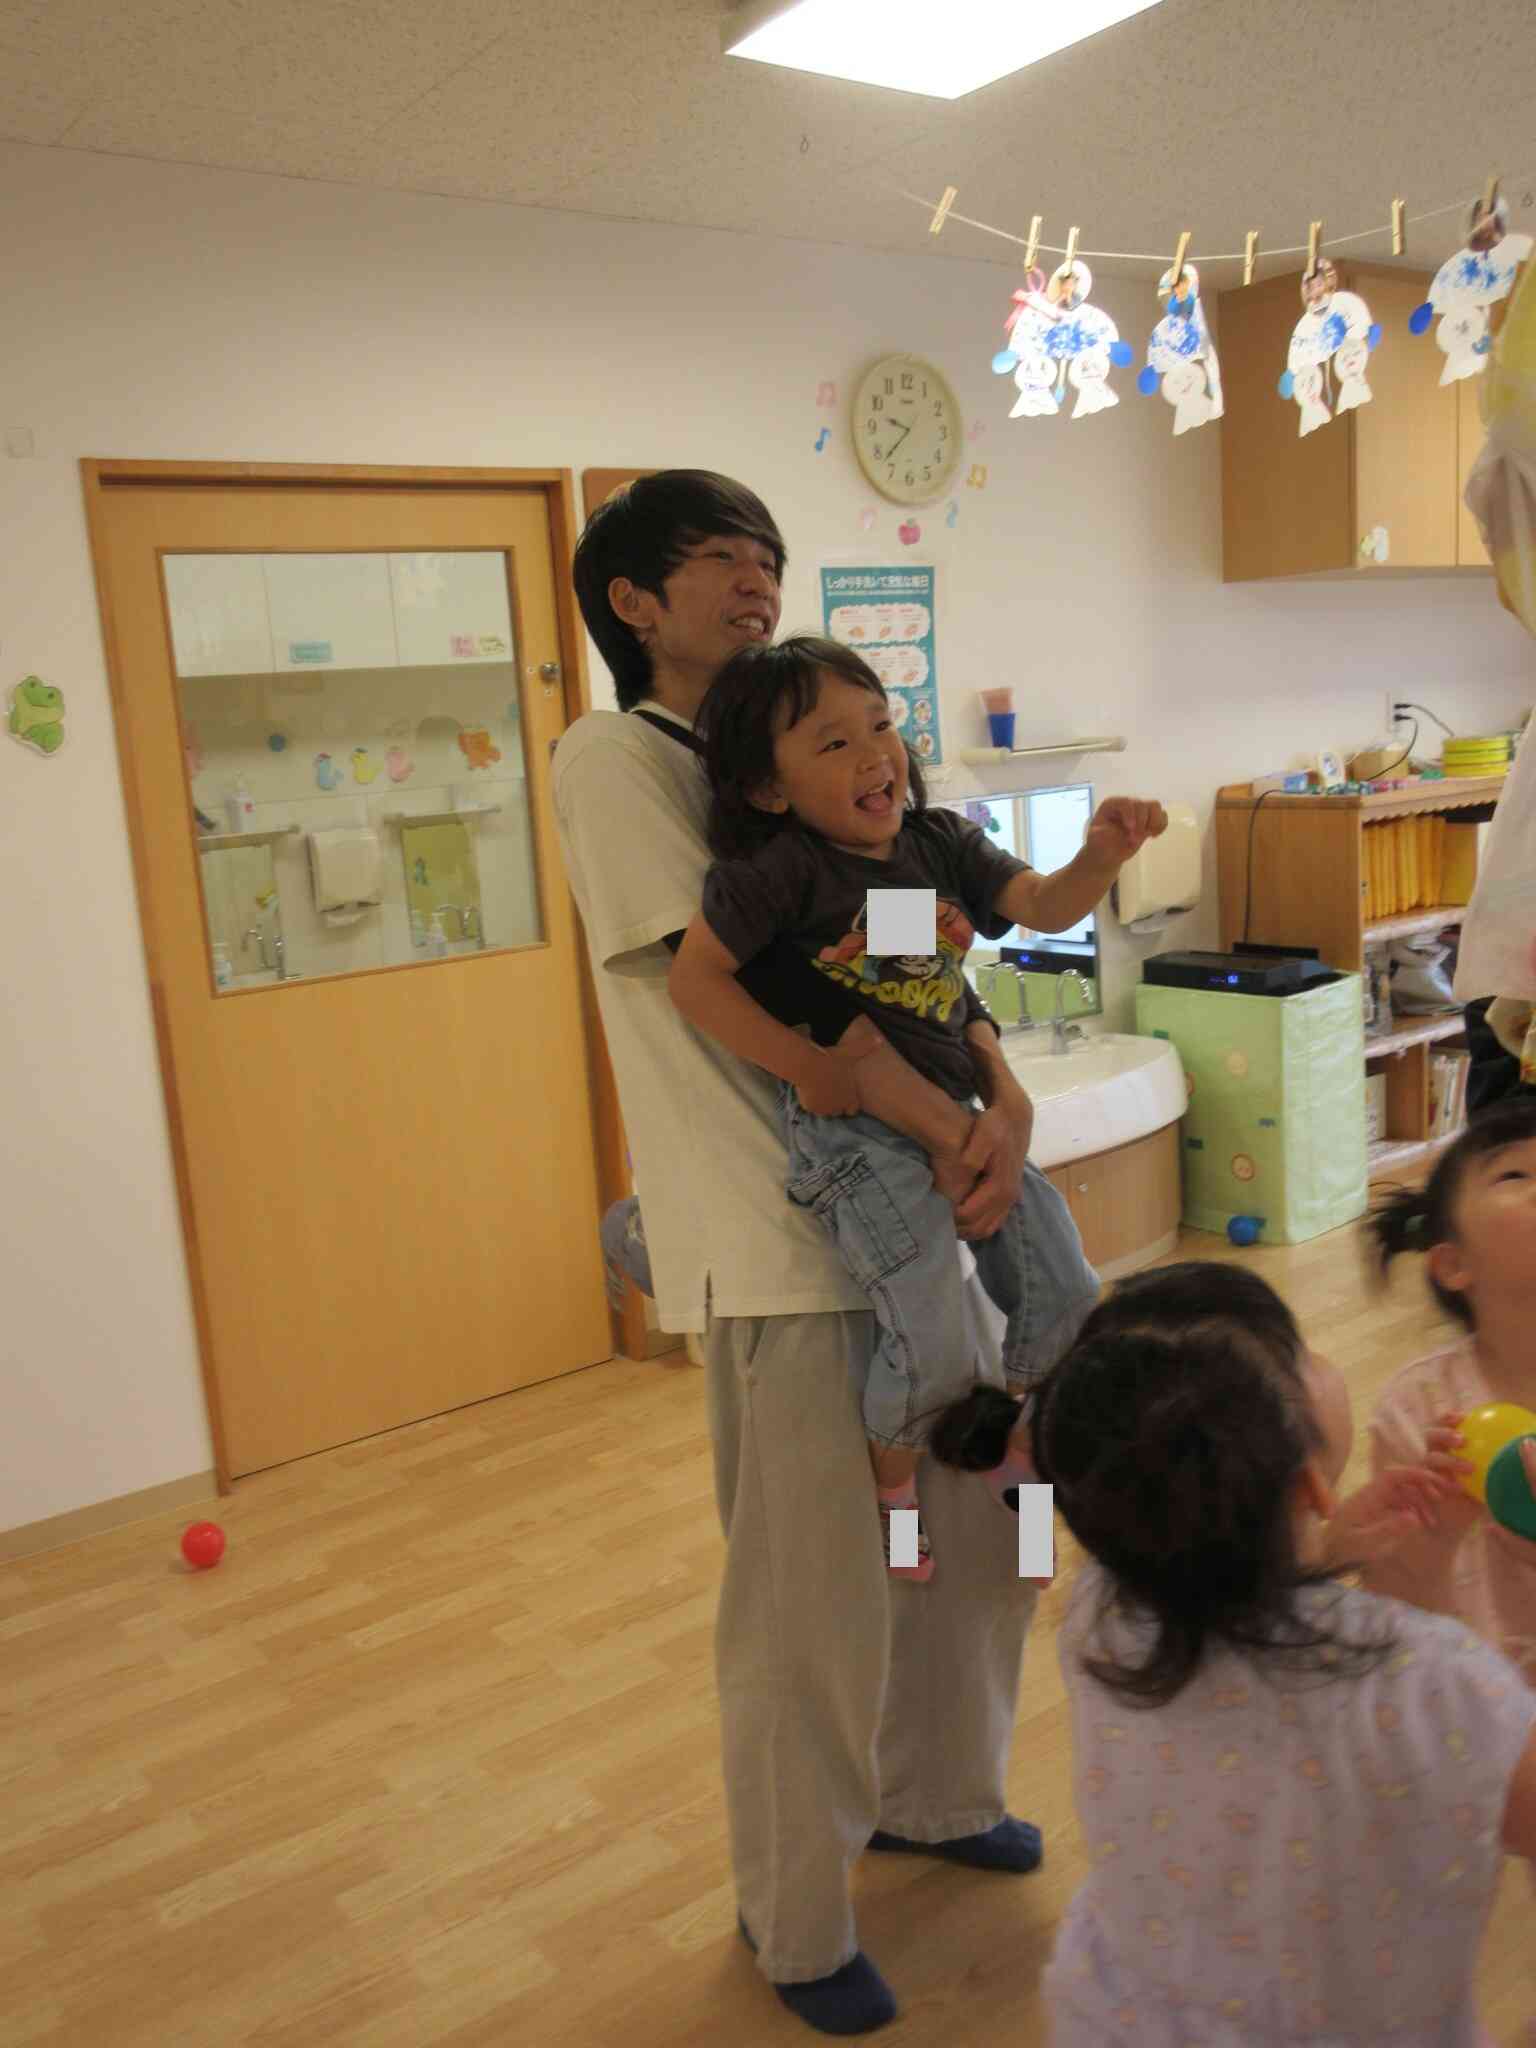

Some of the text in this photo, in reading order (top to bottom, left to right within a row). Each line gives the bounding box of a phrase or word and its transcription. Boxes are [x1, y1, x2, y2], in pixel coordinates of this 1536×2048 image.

[884, 378, 894, 395] 11
[901, 373, 913, 390] 12
[921, 381, 928, 399] 1
[872, 394, 884, 411] 10
[933, 400, 943, 417] 2
[867, 418, 877, 435] 9
[937, 424, 948, 441] 3
[873, 443, 883, 460] 8
[932, 447, 942, 464] 4
[886, 462, 896, 480] 7
[904, 469, 915, 487] 6
[921, 465, 932, 481] 5
